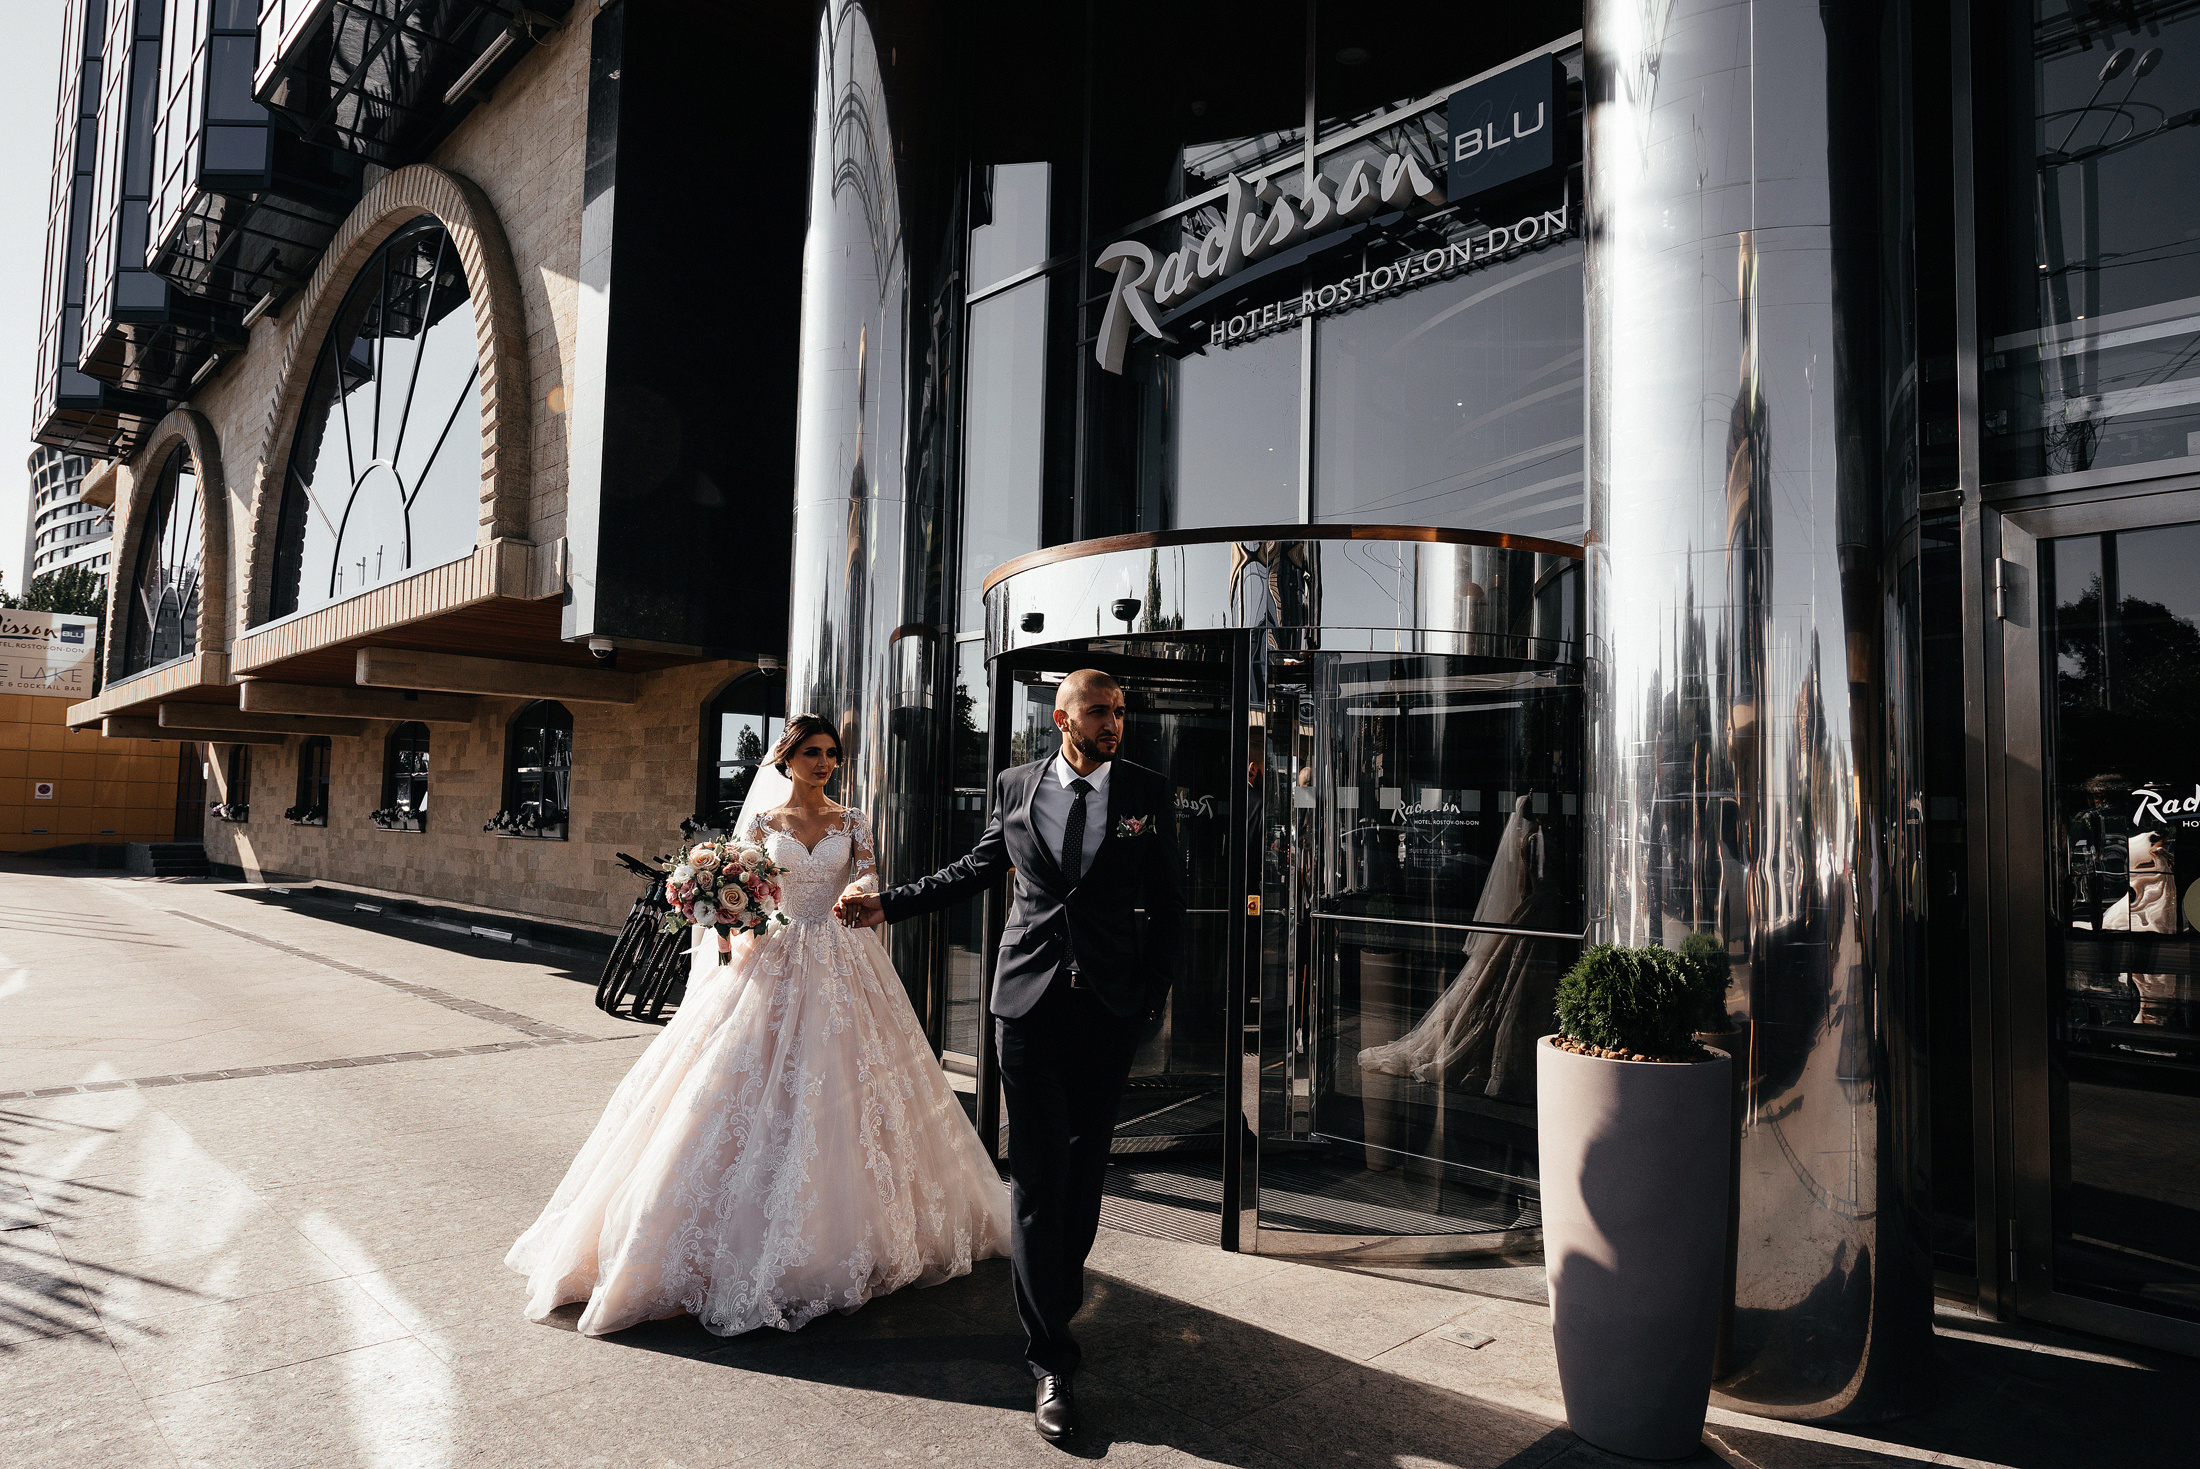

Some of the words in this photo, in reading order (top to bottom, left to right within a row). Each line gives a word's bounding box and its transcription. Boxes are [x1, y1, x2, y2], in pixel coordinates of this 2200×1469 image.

[1095, 152, 1438, 375] Radisson
[1454, 101, 1545, 163] BLU
[1210, 301, 1295, 345] HOTEL,
[1301, 205, 1569, 312] ROSTOV-ON-DON
[61, 630, 84, 639] BLU
[15, 642, 85, 654] ROSTOV-ON-DON
[20, 665, 83, 683] LAKE
[17, 682, 61, 691] COCKTAIL
